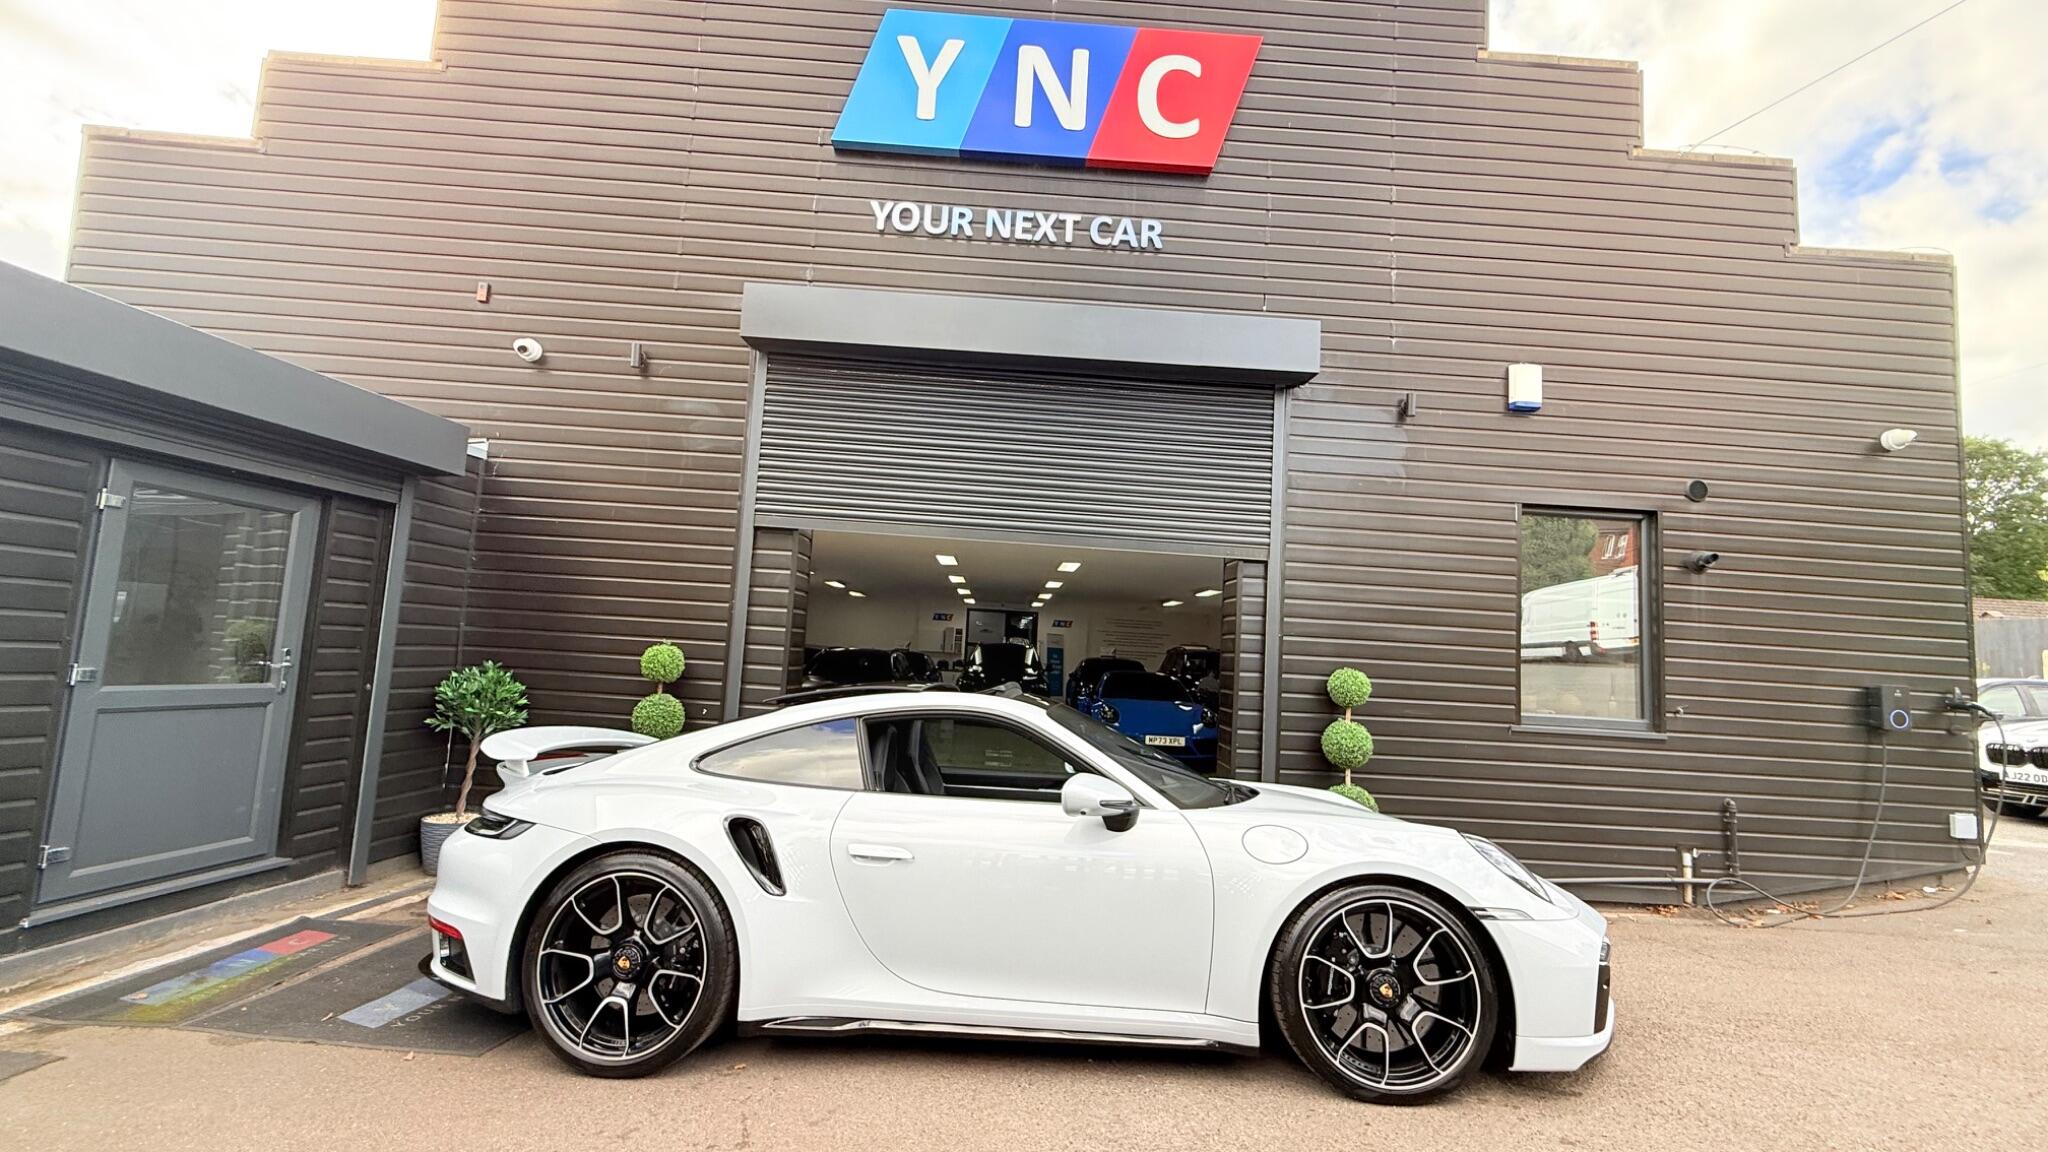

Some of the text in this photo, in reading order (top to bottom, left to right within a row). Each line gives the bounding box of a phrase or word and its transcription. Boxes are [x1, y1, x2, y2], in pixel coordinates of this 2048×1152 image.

[896, 35, 1202, 139] YNC
[870, 199, 1164, 249] YOUR NEXT CAR
